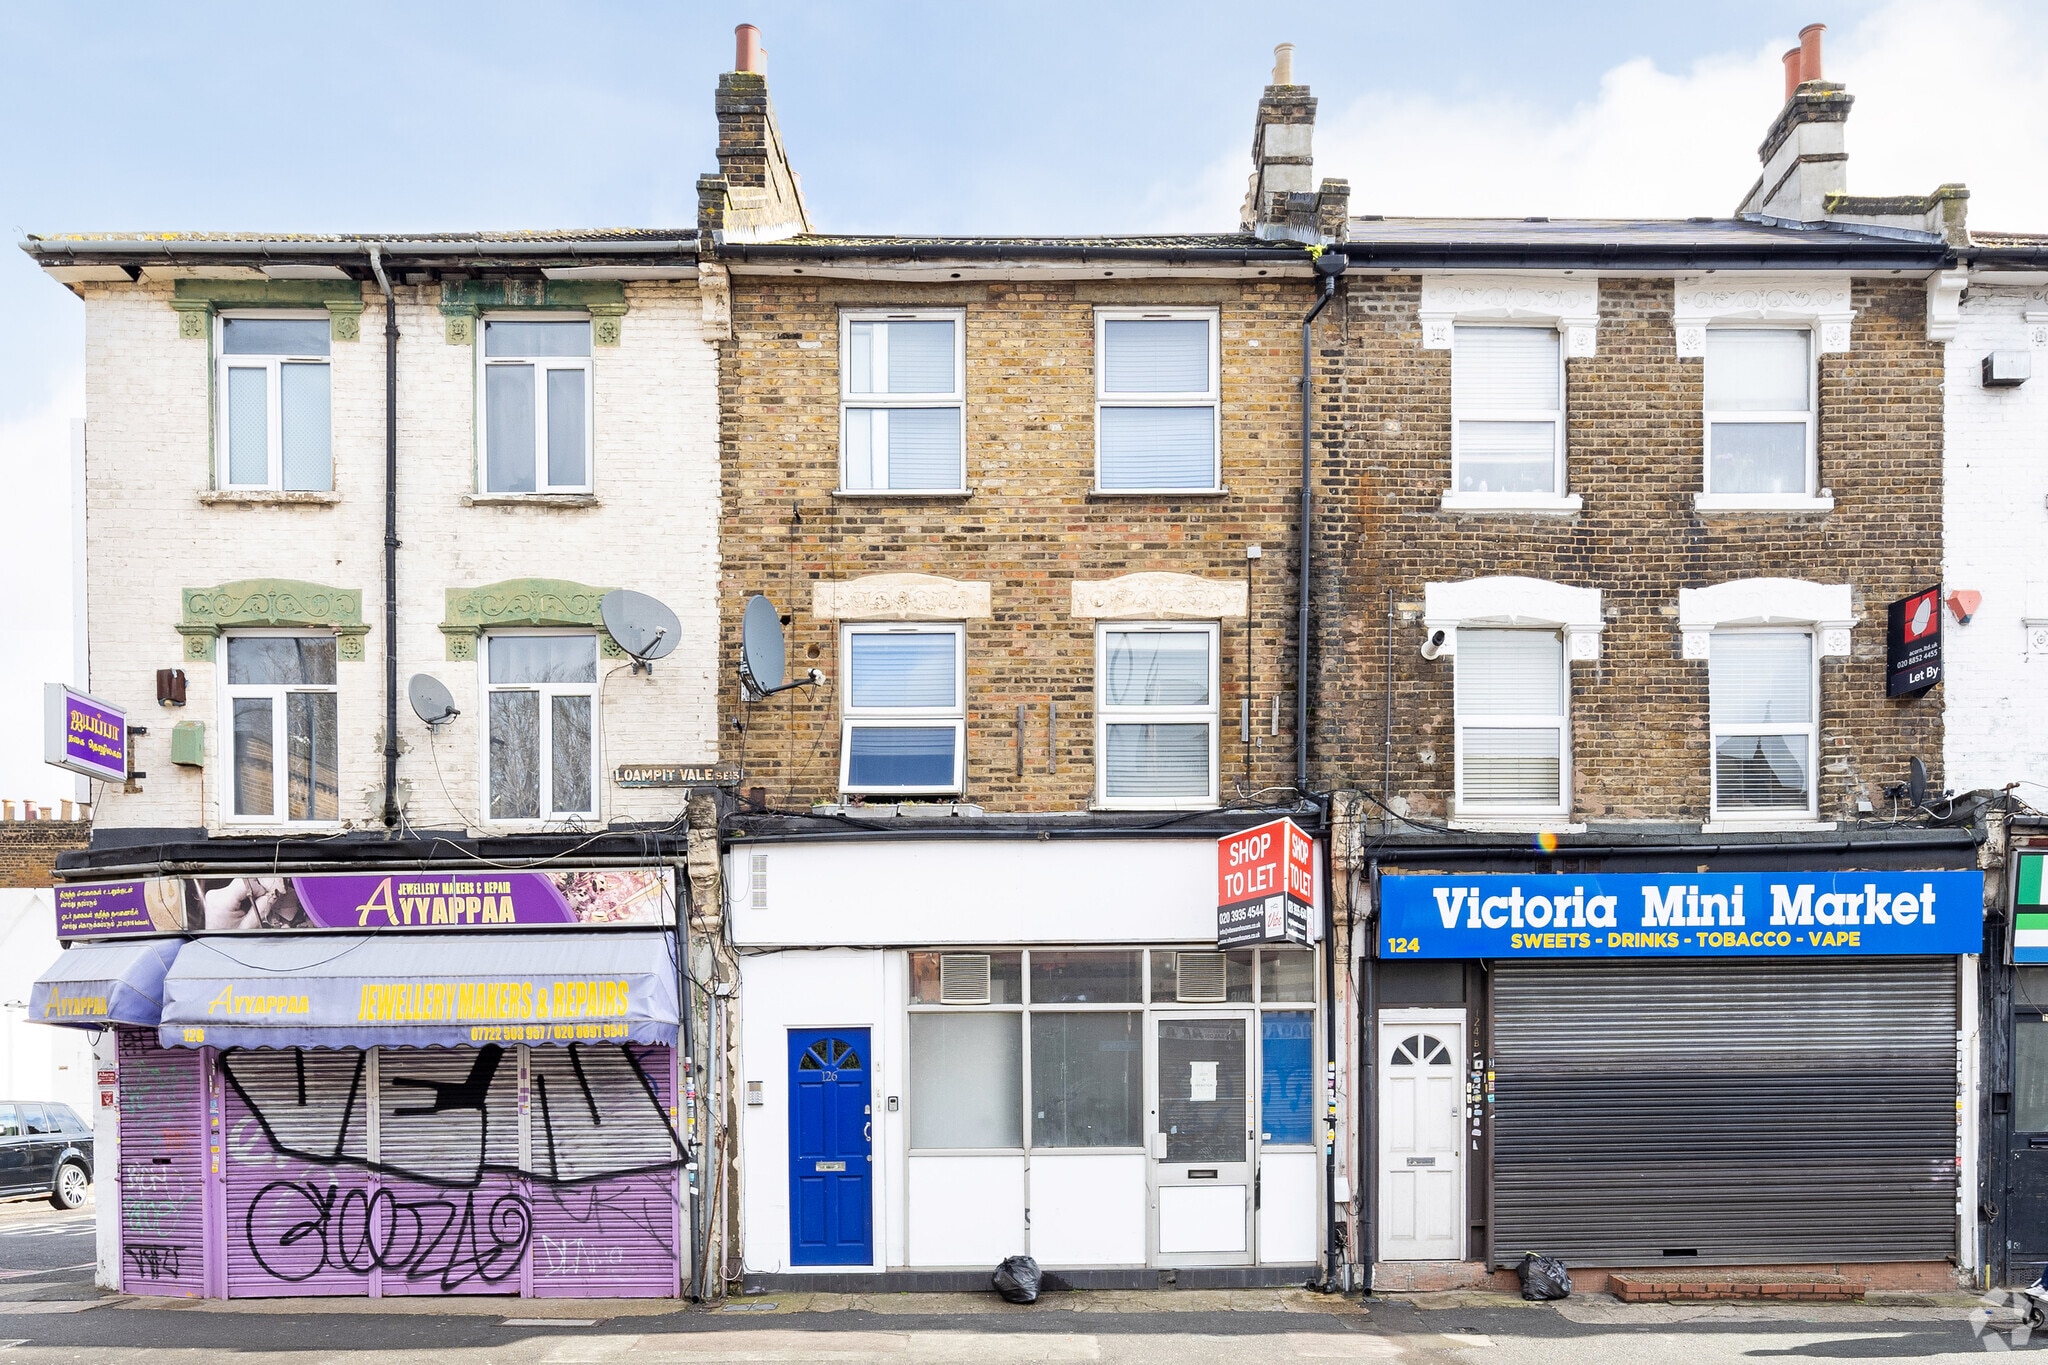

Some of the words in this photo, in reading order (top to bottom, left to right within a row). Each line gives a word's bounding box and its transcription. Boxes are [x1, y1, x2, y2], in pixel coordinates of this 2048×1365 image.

[1896, 660, 1908, 669] 020
[1908, 654, 1923, 665] 8852
[1923, 649, 1938, 659] 4455
[1909, 671, 1925, 684] Let
[1926, 666, 1939, 679] By
[615, 769, 675, 782] LOAMPIT
[680, 769, 714, 781] VALE
[1229, 833, 1271, 866] SHOP
[1292, 833, 1308, 865] SHOP
[398, 882, 440, 896] JEWELLERY
[442, 882, 474, 895] MAKERS
[476, 882, 482, 894] &
[484, 882, 511, 894] REPAIR
[1224, 872, 1244, 898] TO
[1248, 862, 1276, 893] LET
[1290, 862, 1299, 890] TO
[1299, 869, 1311, 897] LET
[355, 877, 516, 927] AYYAPPAA
[1247, 904, 1264, 919] 4544
[1432, 886, 1617, 929] Victoria
[1641, 884, 1746, 926] Mini
[1770, 883, 1936, 926] Market
[1388, 937, 1420, 953] 124
[1511, 932, 1591, 949] SWEETS
[1608, 932, 1679, 948] DRINKS
[1696, 931, 1791, 947] TOBACCO
[1808, 931, 1861, 947] VAPE
[45, 986, 108, 1017] AYYAPPAA
[208, 984, 310, 1015] AYYAPPAA
[358, 984, 456, 1021] JEWELLERY
[457, 982, 533, 1020] MAKERS
[536, 988, 549, 1019] &
[553, 980, 629, 1018] REPAIRS
[183, 1028, 205, 1043] 128
[471, 1027, 501, 1041] 07722
[503, 1027, 524, 1040] 503
[526, 1026, 545, 1040] 957
[554, 1026, 574, 1039] 020
[576, 1025, 601, 1039] 8691
[603, 1024, 628, 1038] 9541
[822, 1071, 838, 1082] 126
